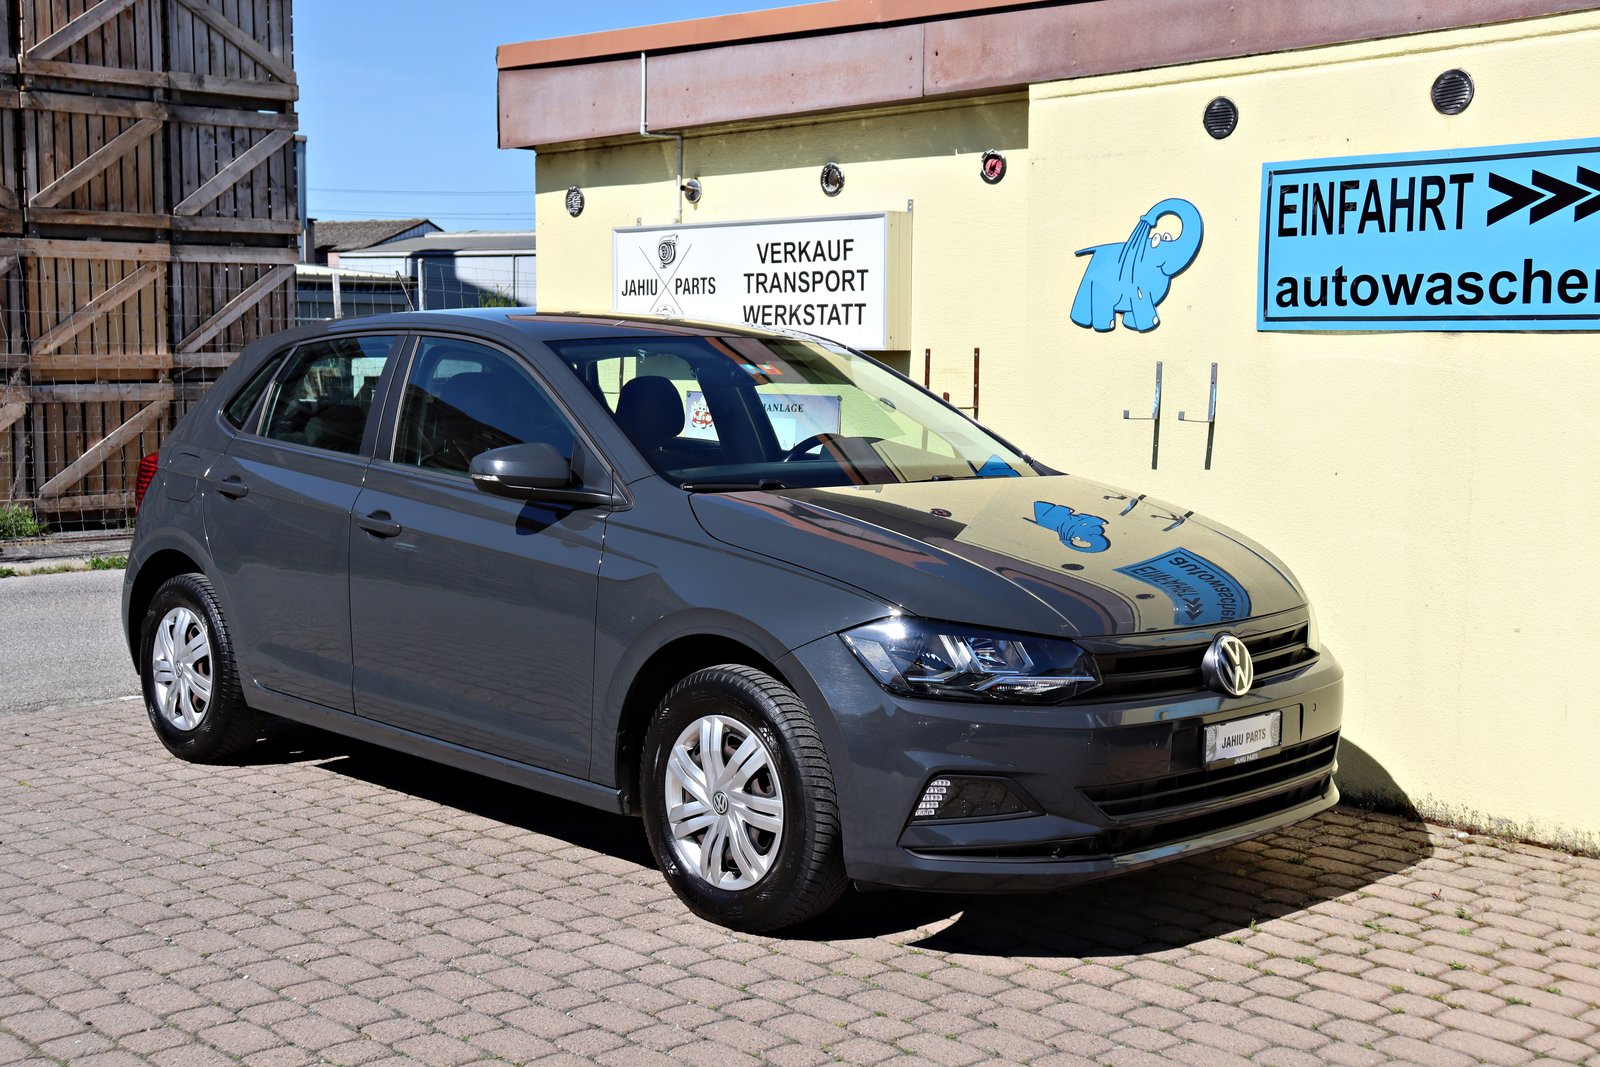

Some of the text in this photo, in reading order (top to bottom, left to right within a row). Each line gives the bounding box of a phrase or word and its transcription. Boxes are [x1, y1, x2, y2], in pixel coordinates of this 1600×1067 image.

[1277, 172, 1475, 238] EINFAHRT
[756, 238, 855, 265] VERKAUF
[621, 276, 717, 297] JAHIU PARTS
[743, 268, 869, 294] TRANSPORT
[1275, 257, 1600, 308] autowasche
[742, 302, 867, 326] WERKSTATT
[1214, 635, 1253, 696] VW
[1221, 727, 1267, 749] JAHIU PARTS
